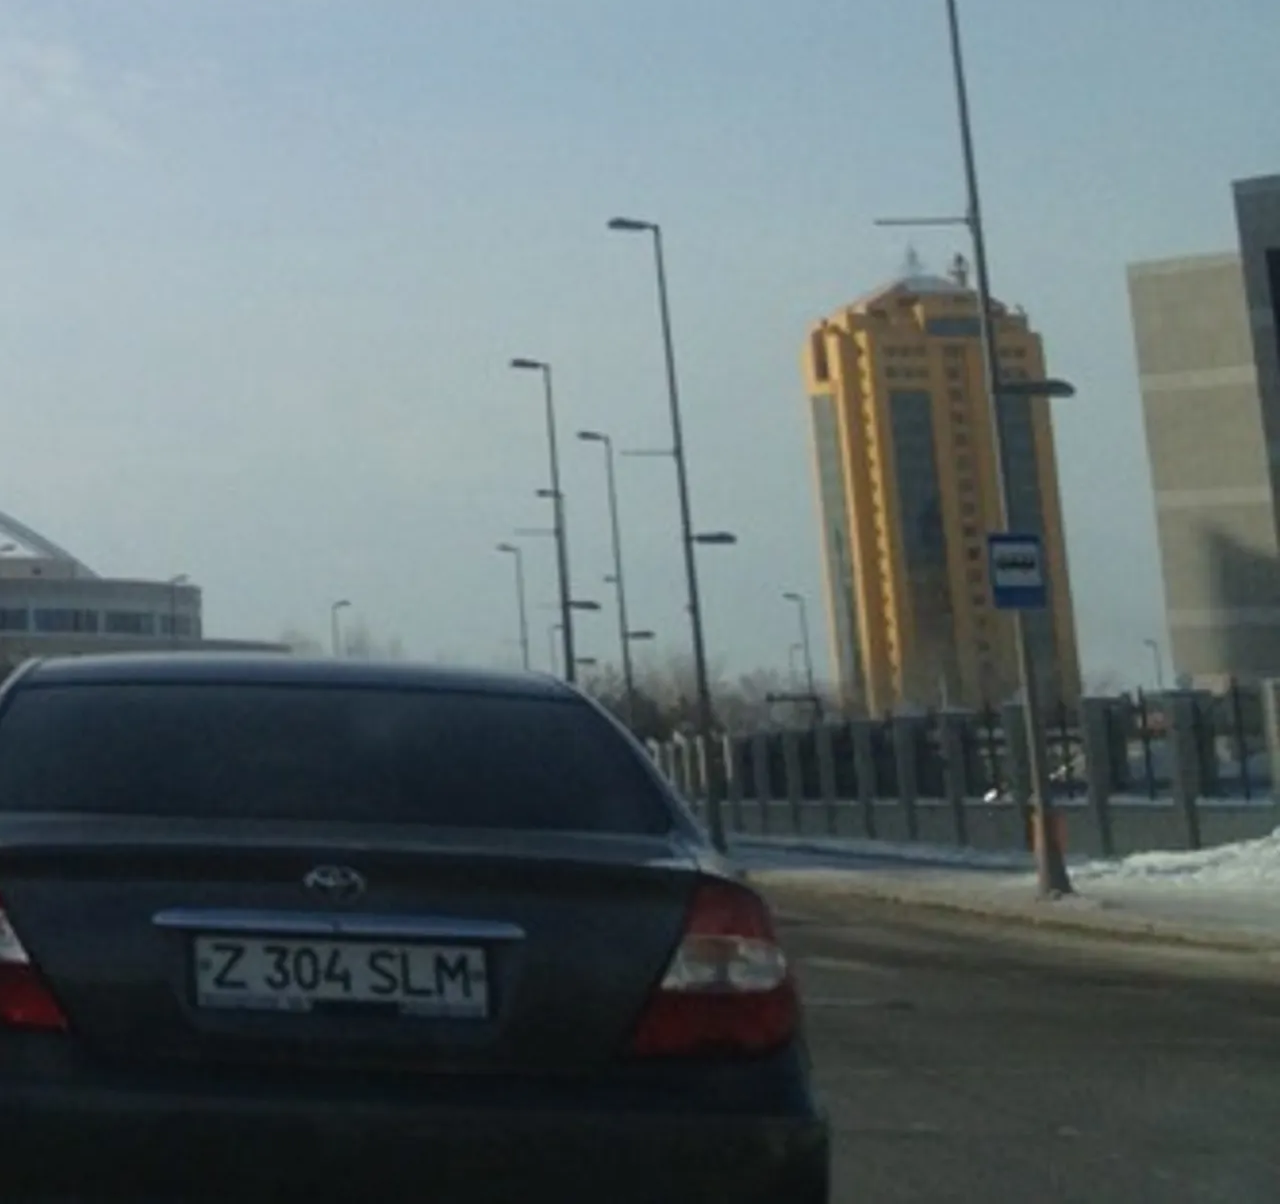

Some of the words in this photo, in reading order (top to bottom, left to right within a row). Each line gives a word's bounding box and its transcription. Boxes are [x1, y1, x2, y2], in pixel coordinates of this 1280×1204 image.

[211, 943, 247, 989] Z
[264, 946, 351, 992] 304
[369, 948, 471, 998] SLM
